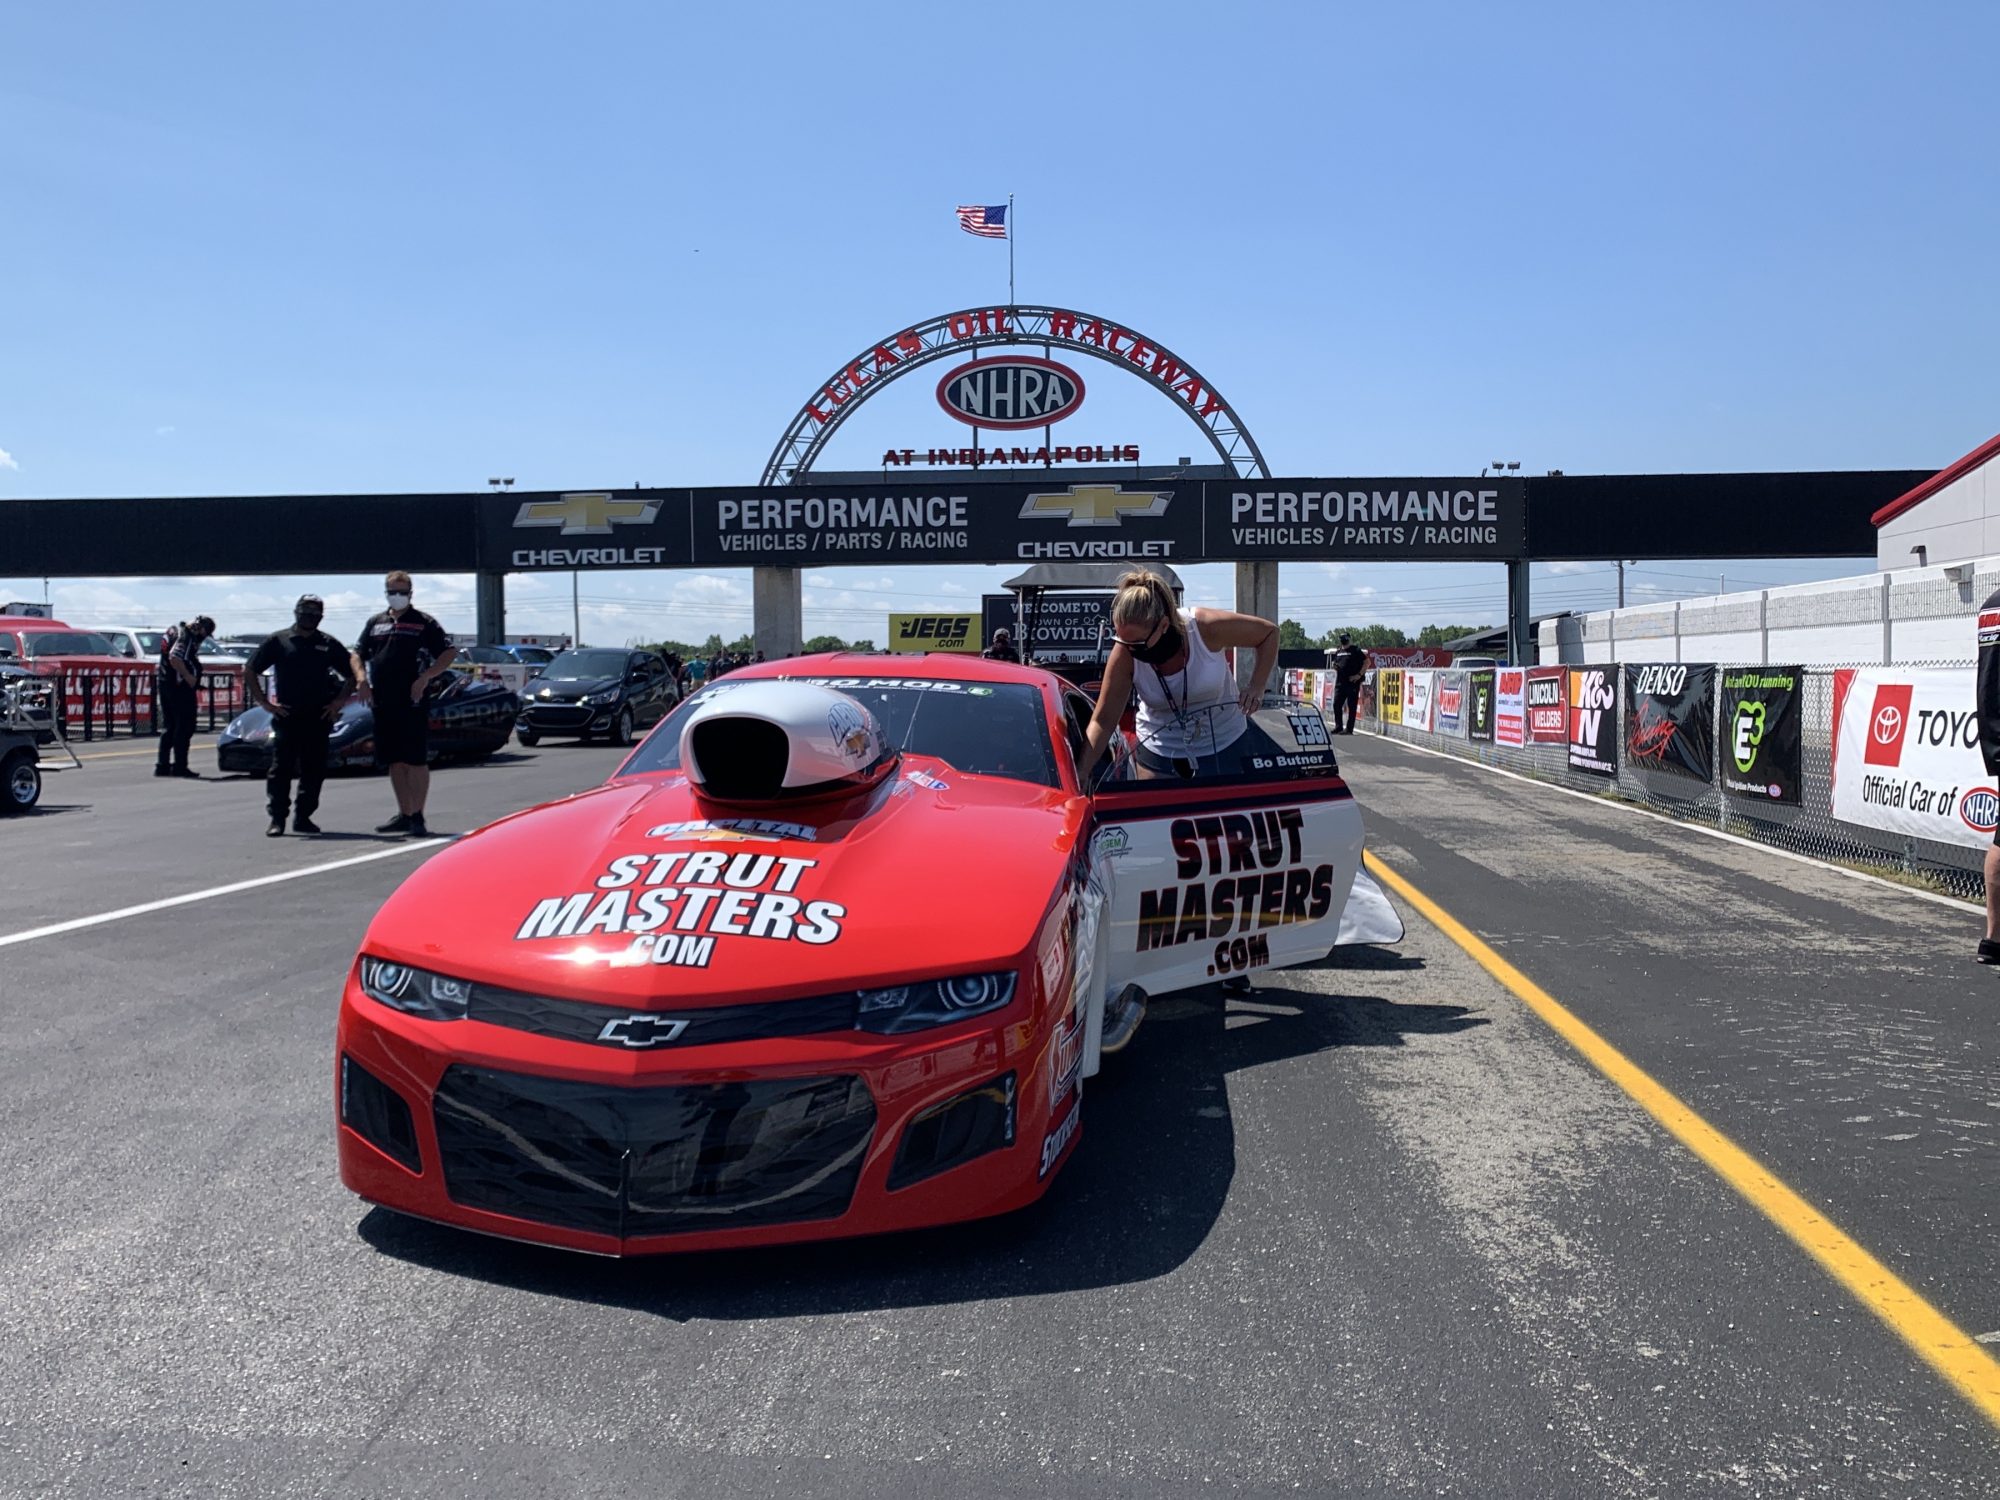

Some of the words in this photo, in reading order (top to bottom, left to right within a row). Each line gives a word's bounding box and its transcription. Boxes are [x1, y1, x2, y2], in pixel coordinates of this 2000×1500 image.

[806, 328, 922, 425] LUCAS
[949, 308, 1014, 339] OIL
[1049, 310, 1228, 419] RACEWAY
[960, 368, 1065, 419] NHRA
[882, 449, 914, 467] AT
[928, 445, 1140, 466] INDIANAPOLIS
[718, 496, 969, 531] PERFORMANCE
[1231, 490, 1499, 524] PERFORMANCE
[719, 533, 807, 552] VEHICLES
[825, 532, 883, 551] PARTS
[900, 531, 968, 549] RACING
[1232, 527, 1325, 547] VEHICLES
[1343, 526, 1405, 545] PARTS
[1424, 526, 1498, 545] RACING
[512, 546, 666, 566] CHEVROLET
[1017, 540, 1176, 558] CHEVROLET
[1082, 602, 1101, 613] TO
[900, 617, 971, 639] JEGS
[1065, 618, 1079, 626] OF
[934, 638, 965, 648] .com
[867, 680, 961, 691] MOD
[1636, 665, 1687, 697] DENSO
[1529, 681, 1559, 706] LINCOLN
[1534, 710, 1562, 728] WELDERS
[1252, 758, 1273, 769] Bo
[1276, 754, 1324, 767] Butner
[1862, 774, 1908, 809] Official
[1909, 781, 1936, 813] Car
[1937, 786, 1958, 817] of
[1170, 808, 1304, 880] STRUT
[595, 851, 819, 892] STRUT
[513, 887, 847, 945] MASTERS
[1136, 864, 1333, 953] MASTERS
[1207, 933, 1270, 977] .COM
